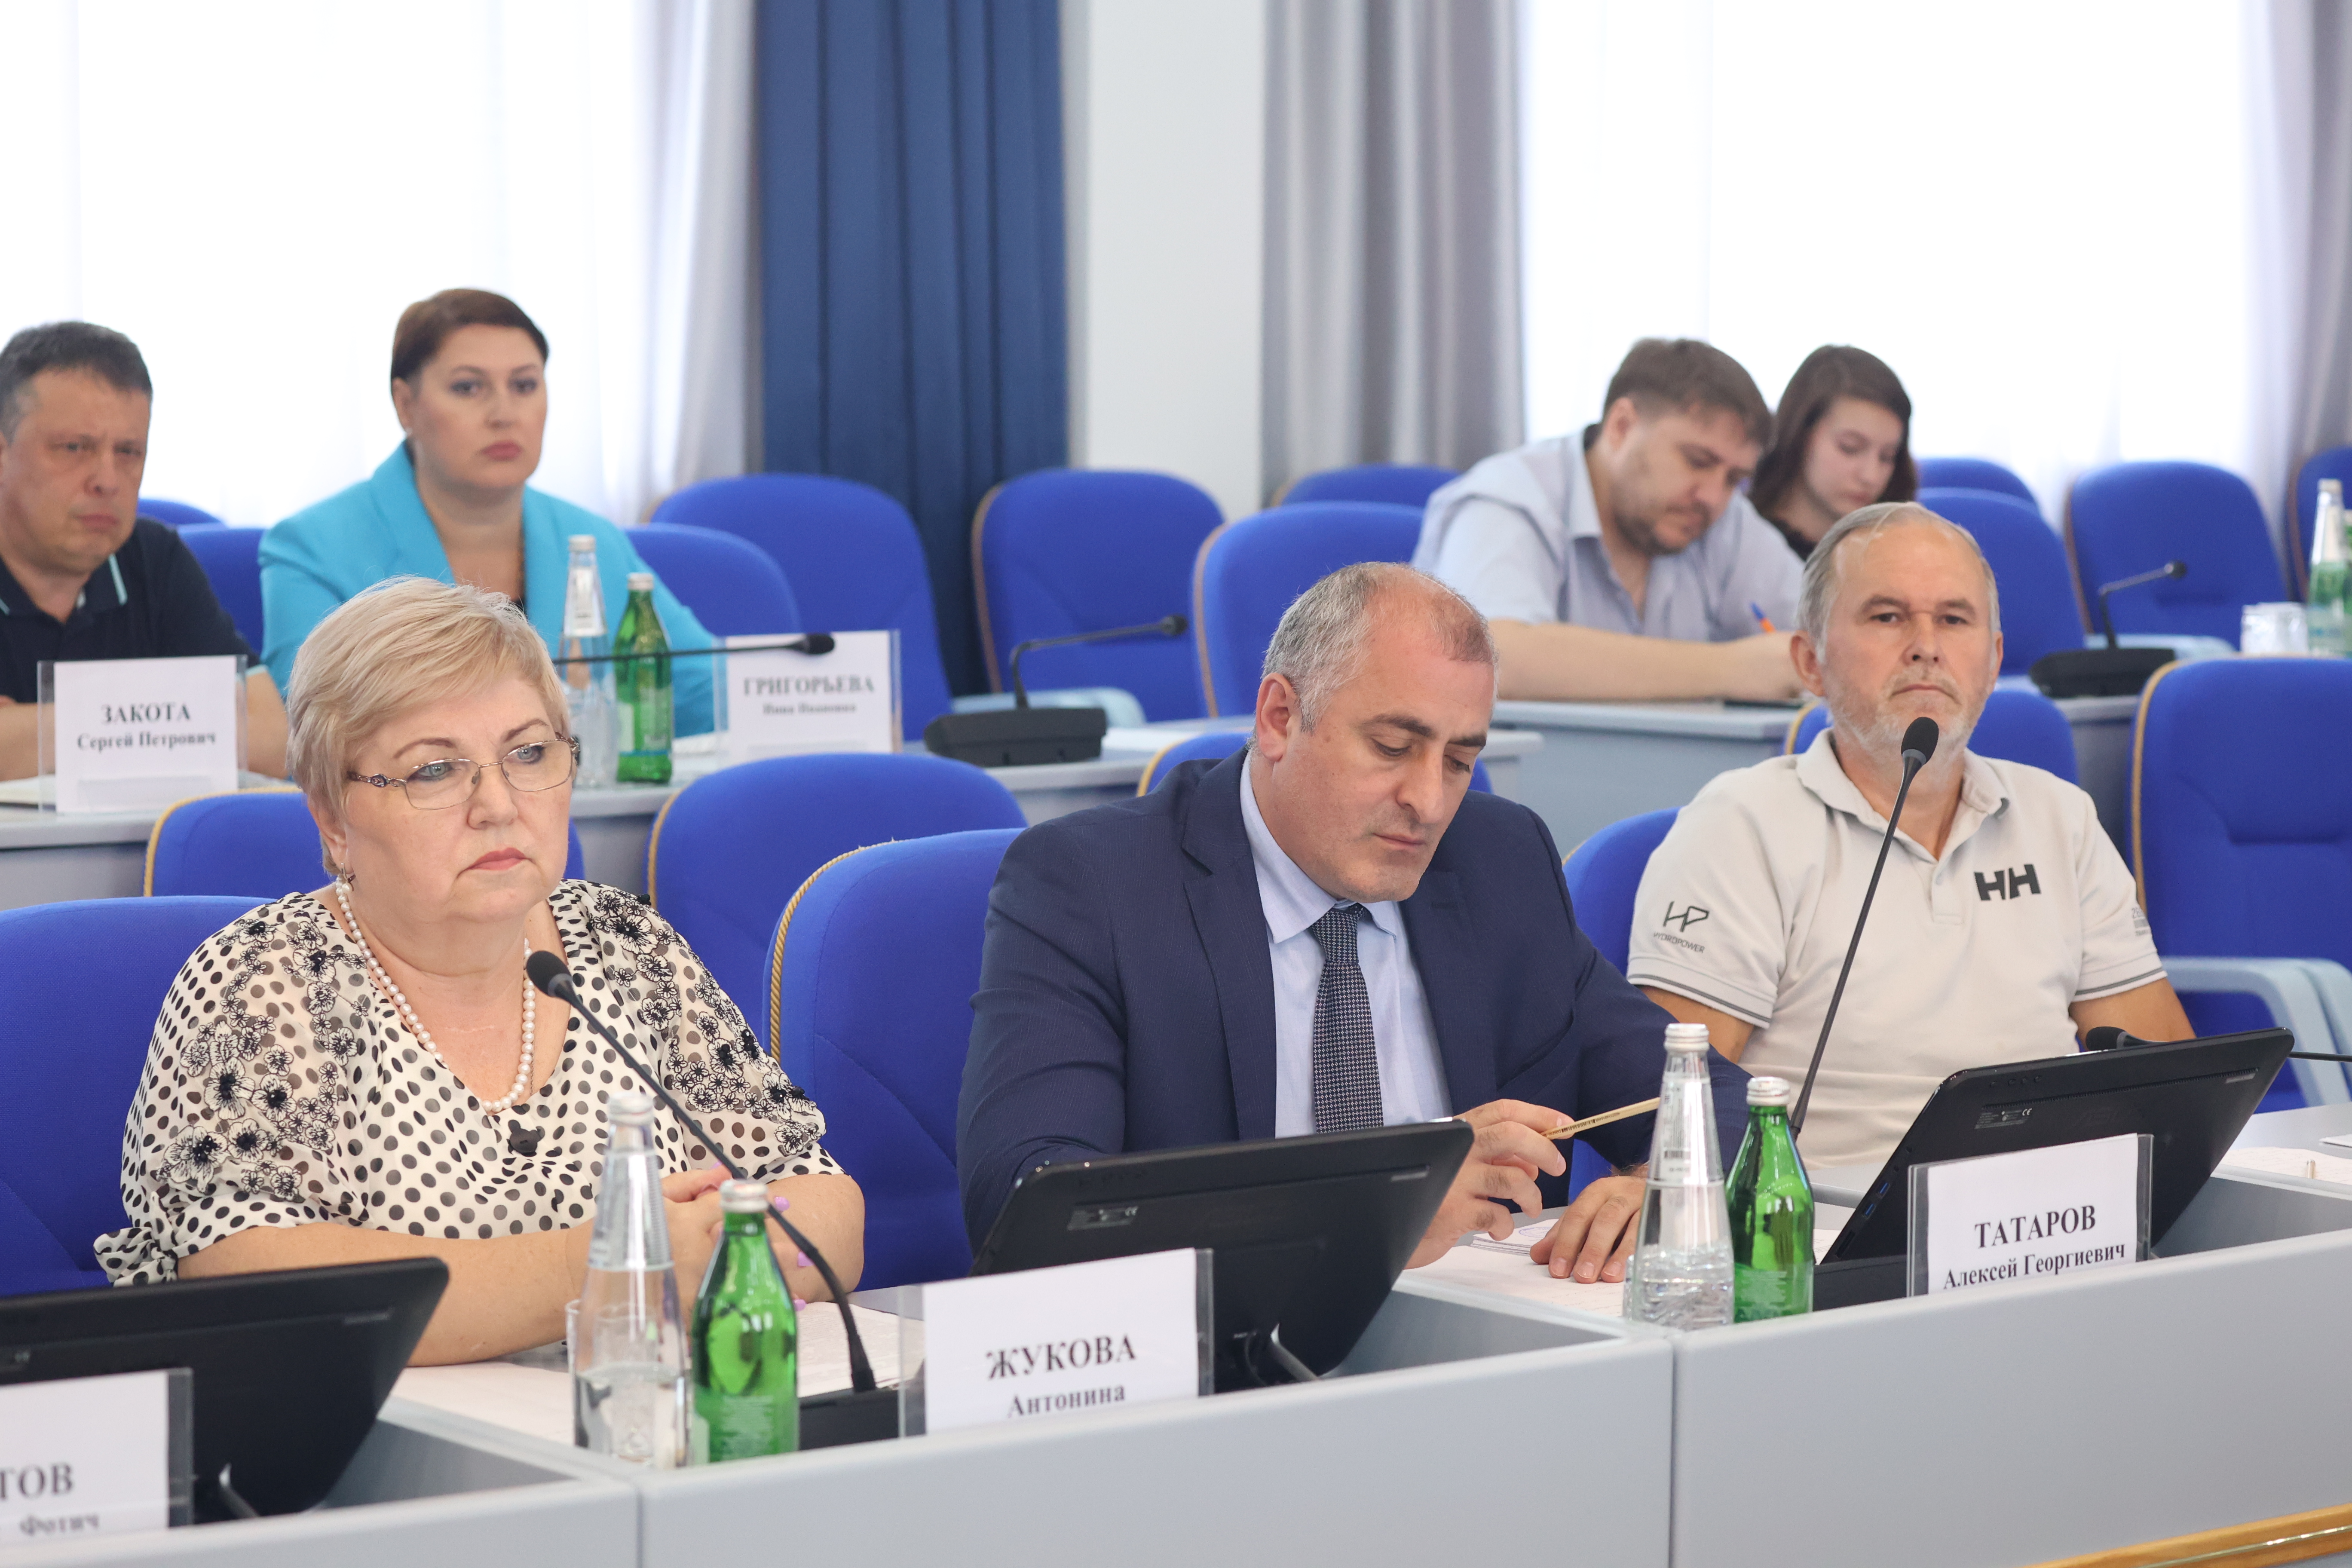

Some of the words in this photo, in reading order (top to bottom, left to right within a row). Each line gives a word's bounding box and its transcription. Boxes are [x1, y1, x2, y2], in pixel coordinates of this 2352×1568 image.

[743, 675, 875, 696] ГРИГОРЬЕВА
[101, 702, 191, 724] ЗАКОТА
[77, 733, 133, 753] Сергей
[139, 730, 216, 750] Петрович
[1974, 864, 2041, 901] HH
[1653, 932, 1705, 953] HYDROPOWER
[1975, 1205, 2096, 1249] ТАТАРОВ
[1943, 1257, 2018, 1289] Алексей
[2023, 1244, 2125, 1275] Георгиевич
[986, 1334, 1136, 1379] ЖУКОВА
[1008, 1385, 1125, 1418] Антонина
